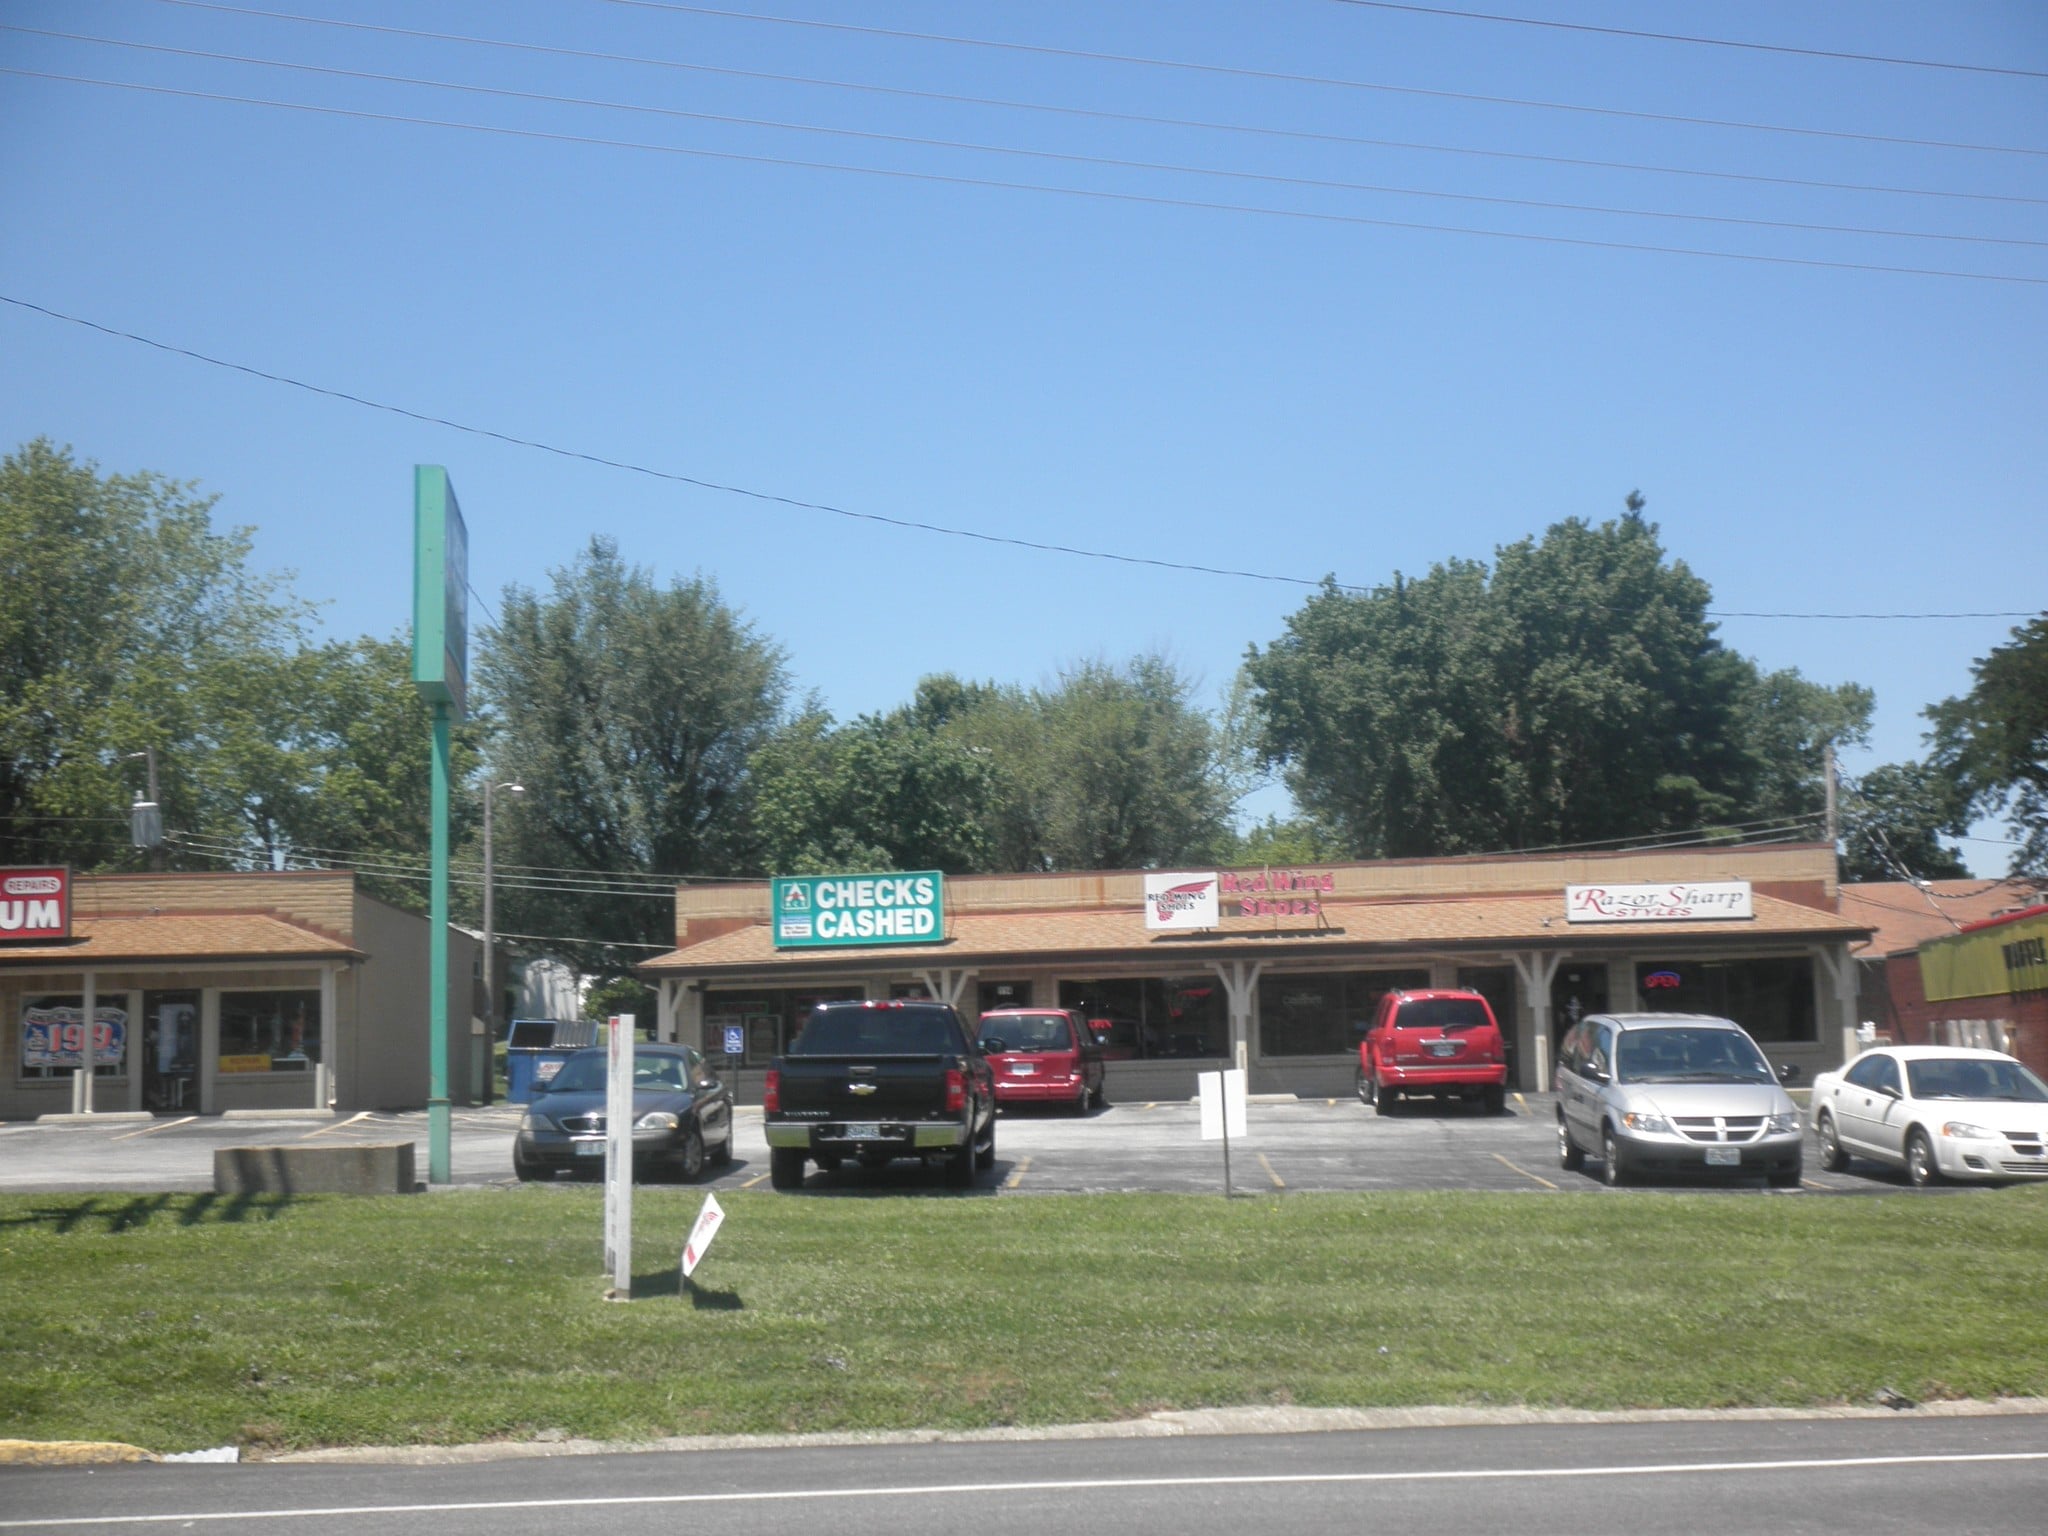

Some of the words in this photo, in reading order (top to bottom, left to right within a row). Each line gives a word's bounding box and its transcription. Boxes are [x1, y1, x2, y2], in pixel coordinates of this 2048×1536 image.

[8, 879, 57, 890] REPAIRS
[1220, 872, 1267, 892] Red
[1271, 870, 1334, 892] Wing
[816, 878, 934, 908] CHECKS
[1148, 893, 1173, 901] RED
[1174, 892, 1206, 900] WING
[1572, 888, 1660, 915] Razor
[1660, 886, 1744, 909] Sharp
[1160, 902, 1195, 911] SHOES
[1240, 897, 1321, 916] Shoes
[1615, 907, 1693, 918] STYLES
[816, 908, 934, 938] CASHED
